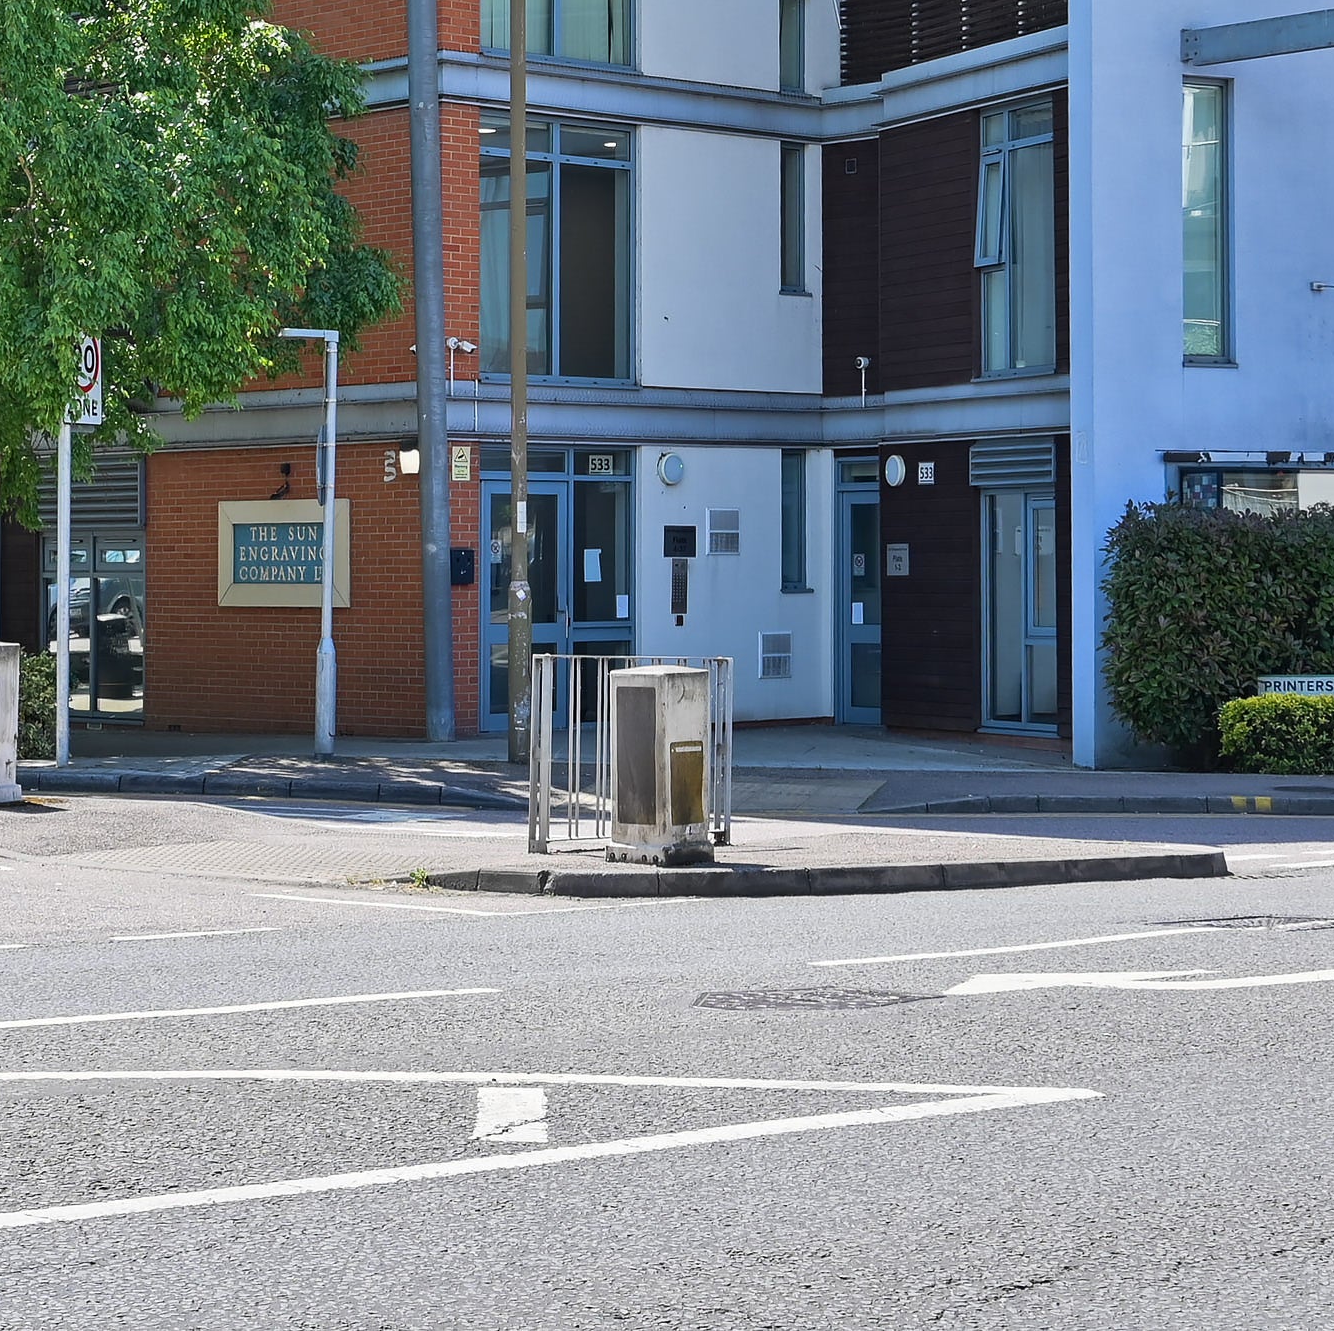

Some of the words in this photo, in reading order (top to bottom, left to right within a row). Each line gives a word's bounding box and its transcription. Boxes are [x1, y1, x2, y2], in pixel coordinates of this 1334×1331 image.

[67, 399, 98, 418] NE
[590, 458, 611, 471] 533
[919, 466, 934, 479] 533
[250, 526, 278, 541] THE
[288, 526, 318, 541] SUN
[239, 566, 307, 581] COMPANY
[1264, 680, 1334, 692] PRINTERS
